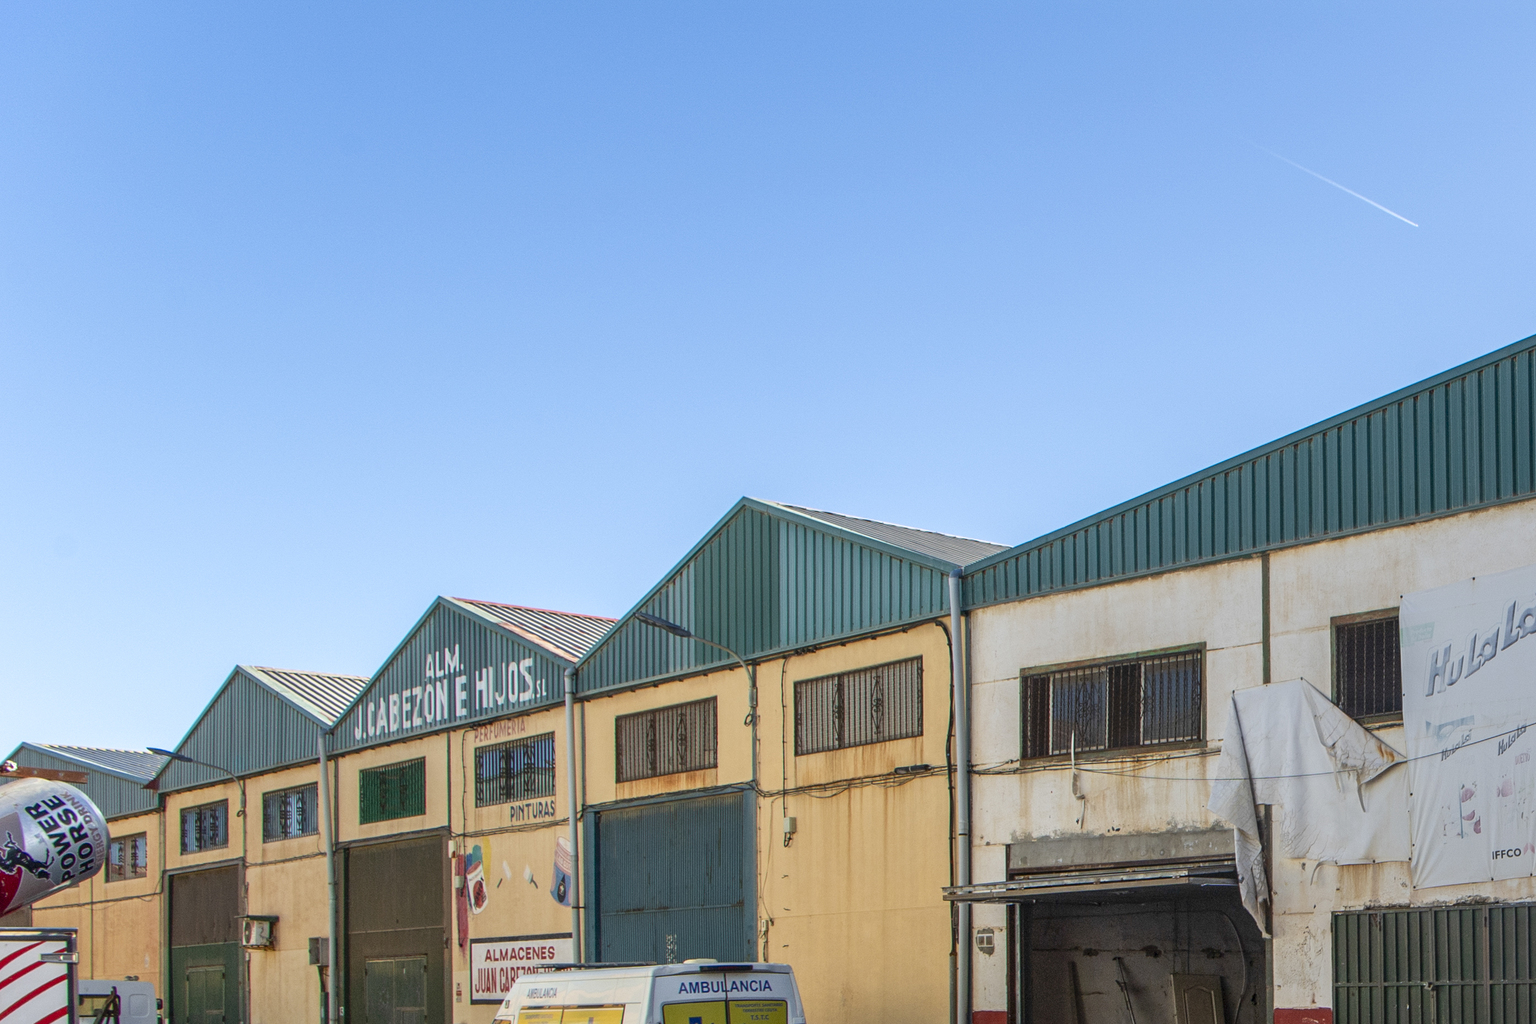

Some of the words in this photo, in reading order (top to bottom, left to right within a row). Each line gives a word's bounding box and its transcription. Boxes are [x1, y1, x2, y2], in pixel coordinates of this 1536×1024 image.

[425, 644, 464, 679] ALM.
[455, 675, 467, 717] E
[474, 717, 526, 743] PERFUMERIA
[61, 791, 95, 825] DRINK
[510, 800, 556, 822] PINTURAS
[24, 802, 76, 883] POWER
[41, 794, 95, 876] HORSE
[1491, 848, 1522, 860] IFFCO
[484, 946, 556, 963] ALMACENES
[475, 966, 497, 994] JUAN
[678, 980, 773, 994] AMBULANCIA
